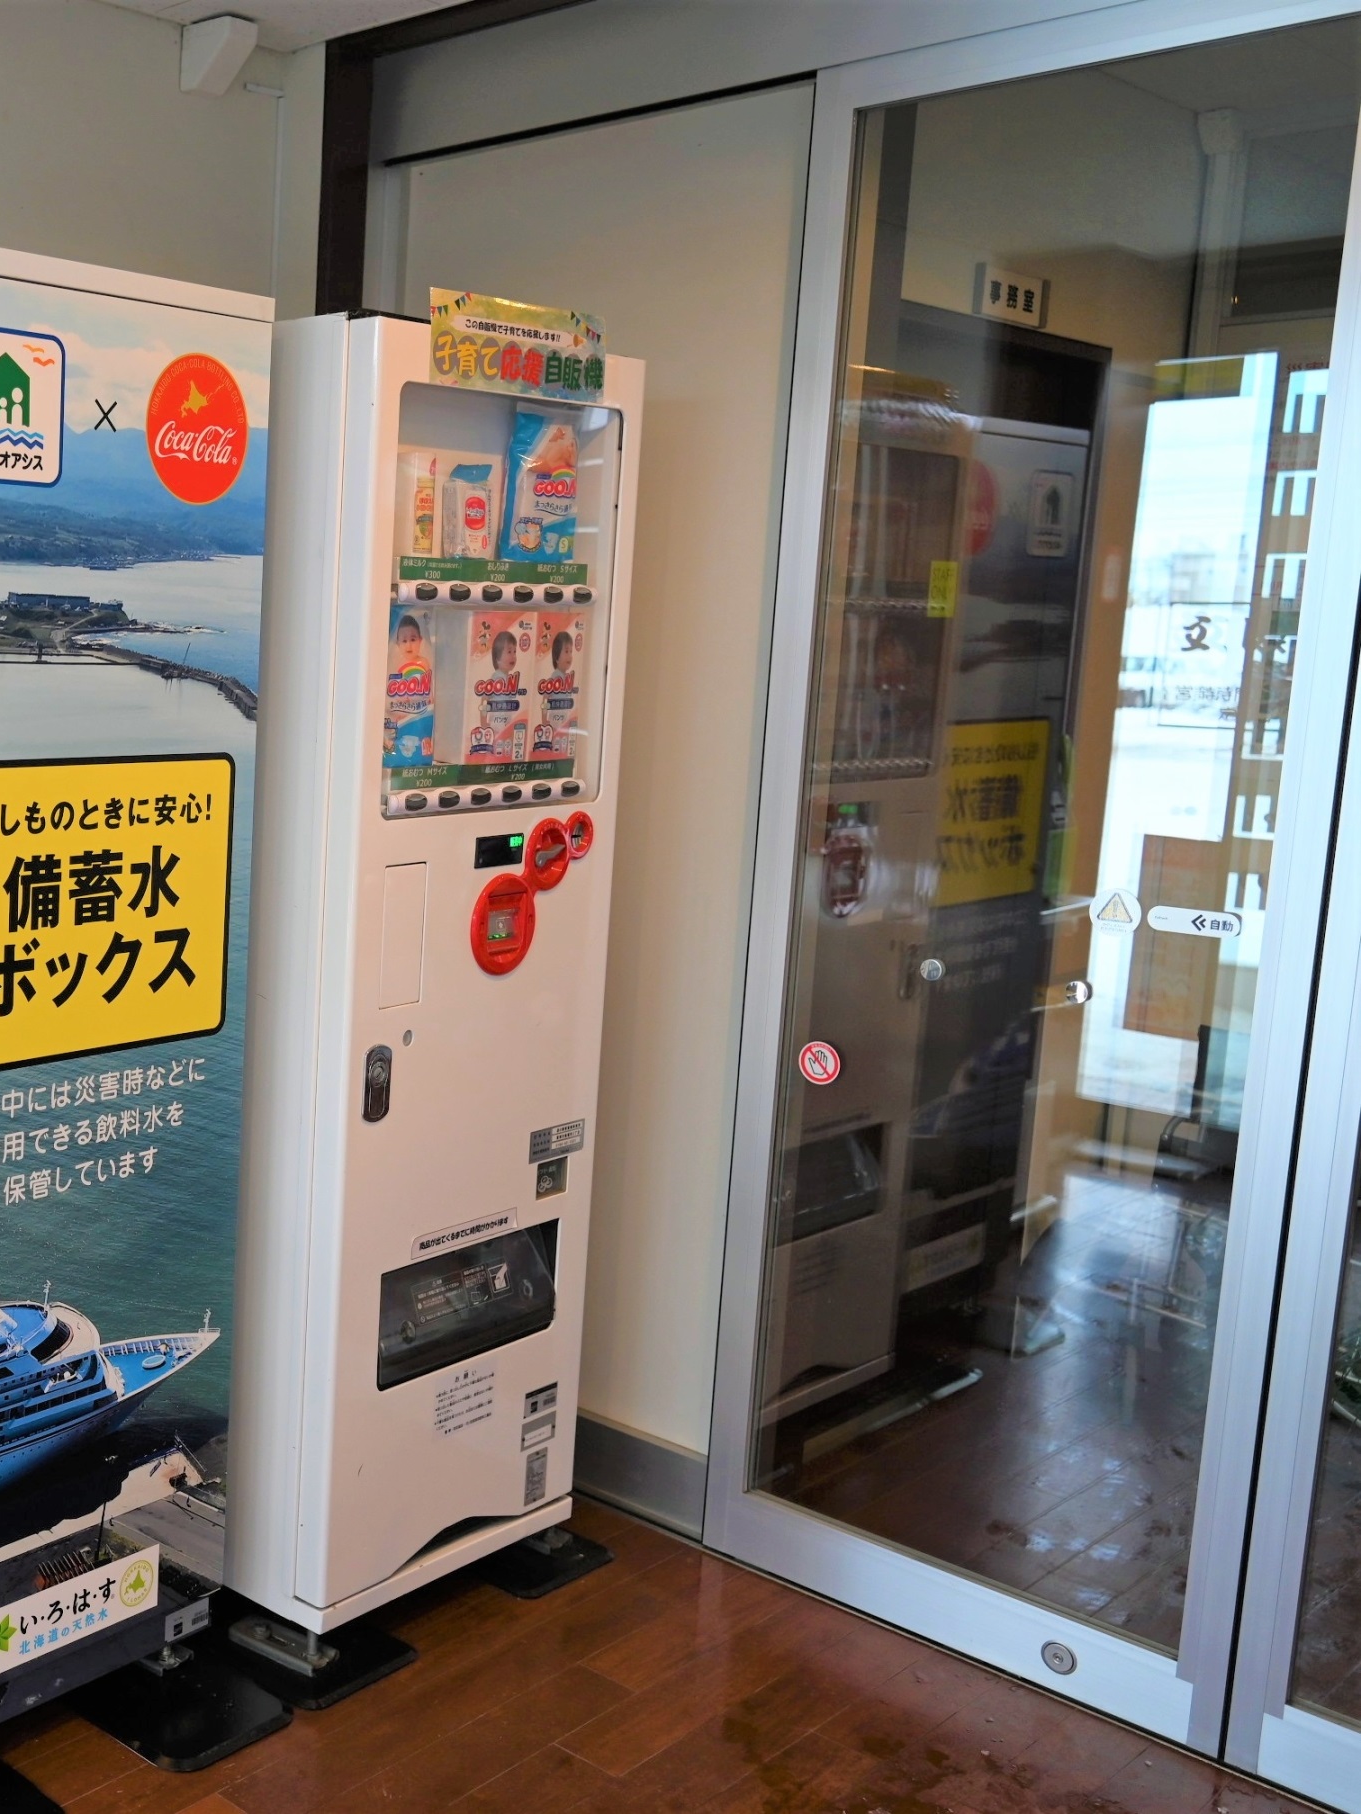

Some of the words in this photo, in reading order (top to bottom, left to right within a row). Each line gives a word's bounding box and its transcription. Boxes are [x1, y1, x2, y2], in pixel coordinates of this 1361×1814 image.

[435, 334, 603, 391] 子育て応援自販機
[425, 571, 441, 579] ¥300
[490, 574, 505, 582] ¥200
[549, 575, 564, 583] ¥200
[416, 779, 432, 787] ¥200
[511, 773, 525, 781] ¥200
[3, 845, 180, 933] 備蓄水
[1210, 919, 1234, 932] 自動
[3, 1146, 158, 1205] 保管しています
[419, 1216, 509, 1250] 商品が出てくるまでに時間がかかります
[19, 1607, 108, 1655] 北海道の天然水
